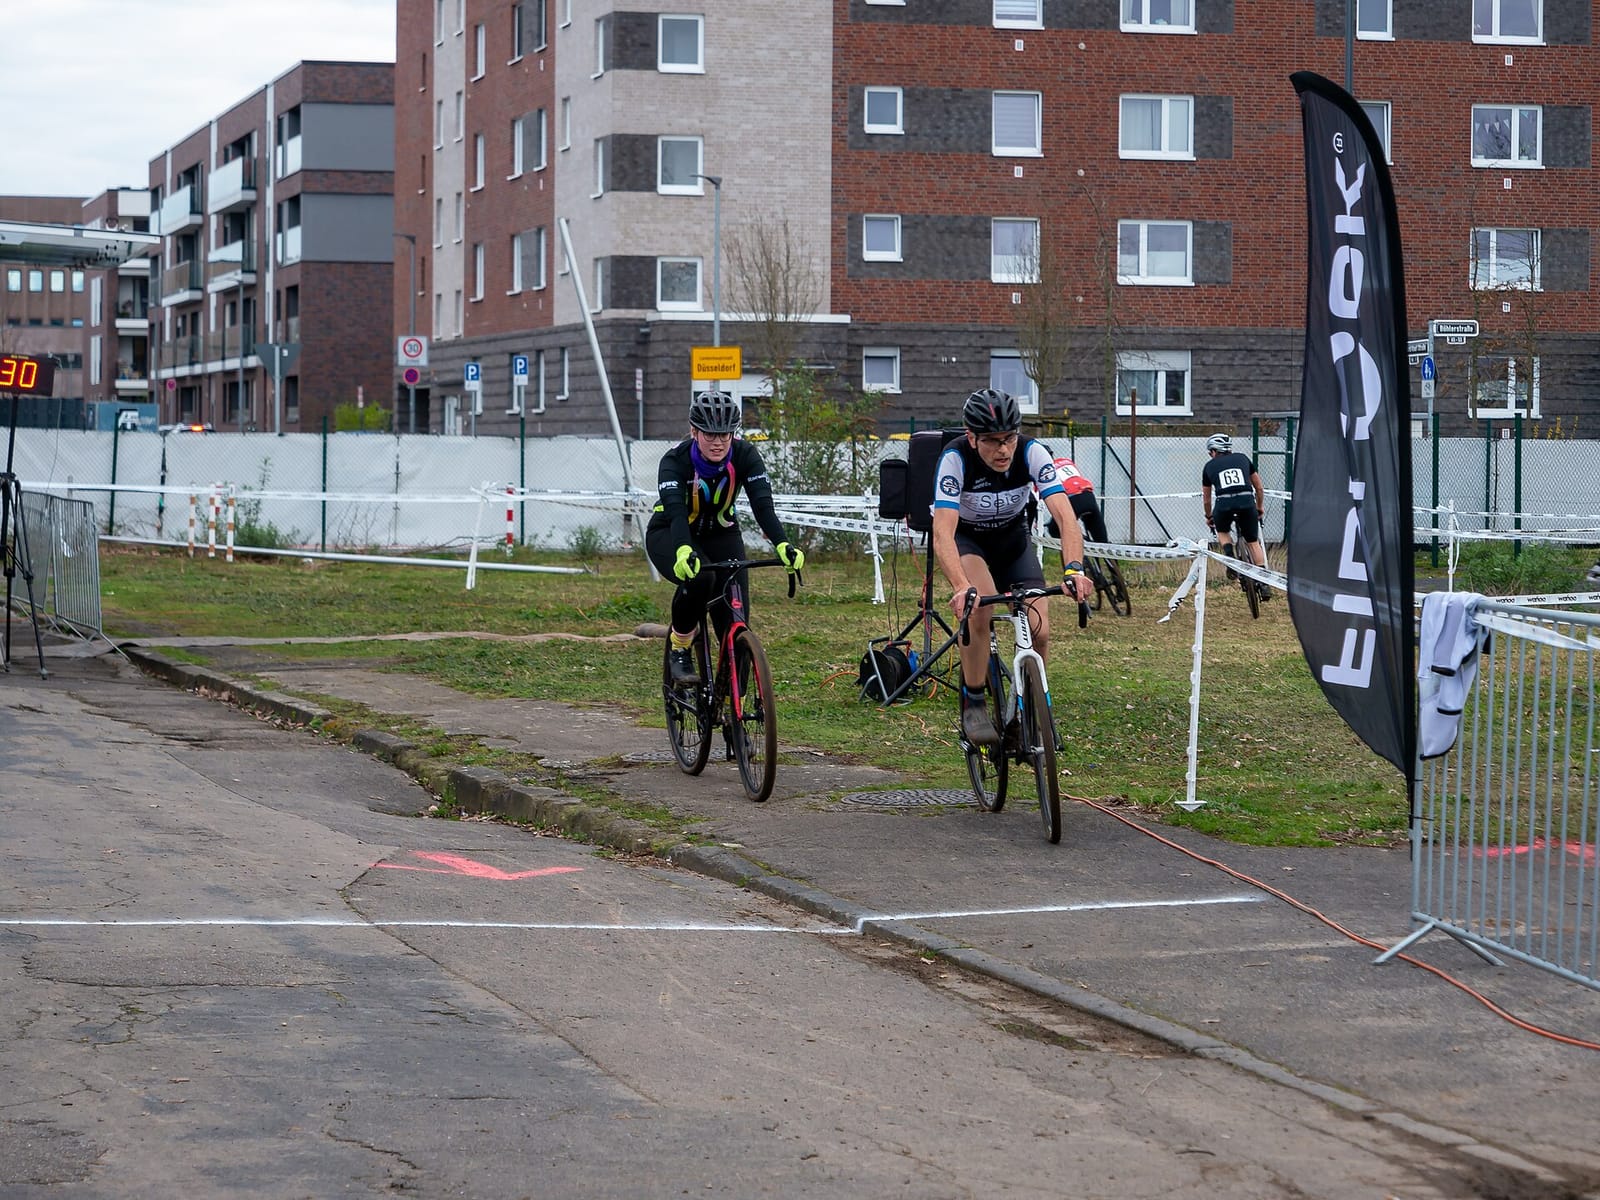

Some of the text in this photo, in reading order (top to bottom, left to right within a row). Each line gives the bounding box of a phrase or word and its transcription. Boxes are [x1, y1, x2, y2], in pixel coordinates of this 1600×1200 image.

[407, 343, 419, 353] 30
[468, 365, 477, 380] P
[517, 358, 525, 374] P
[697, 363, 736, 373] Düsseldorf
[1223, 470, 1240, 485] 63
